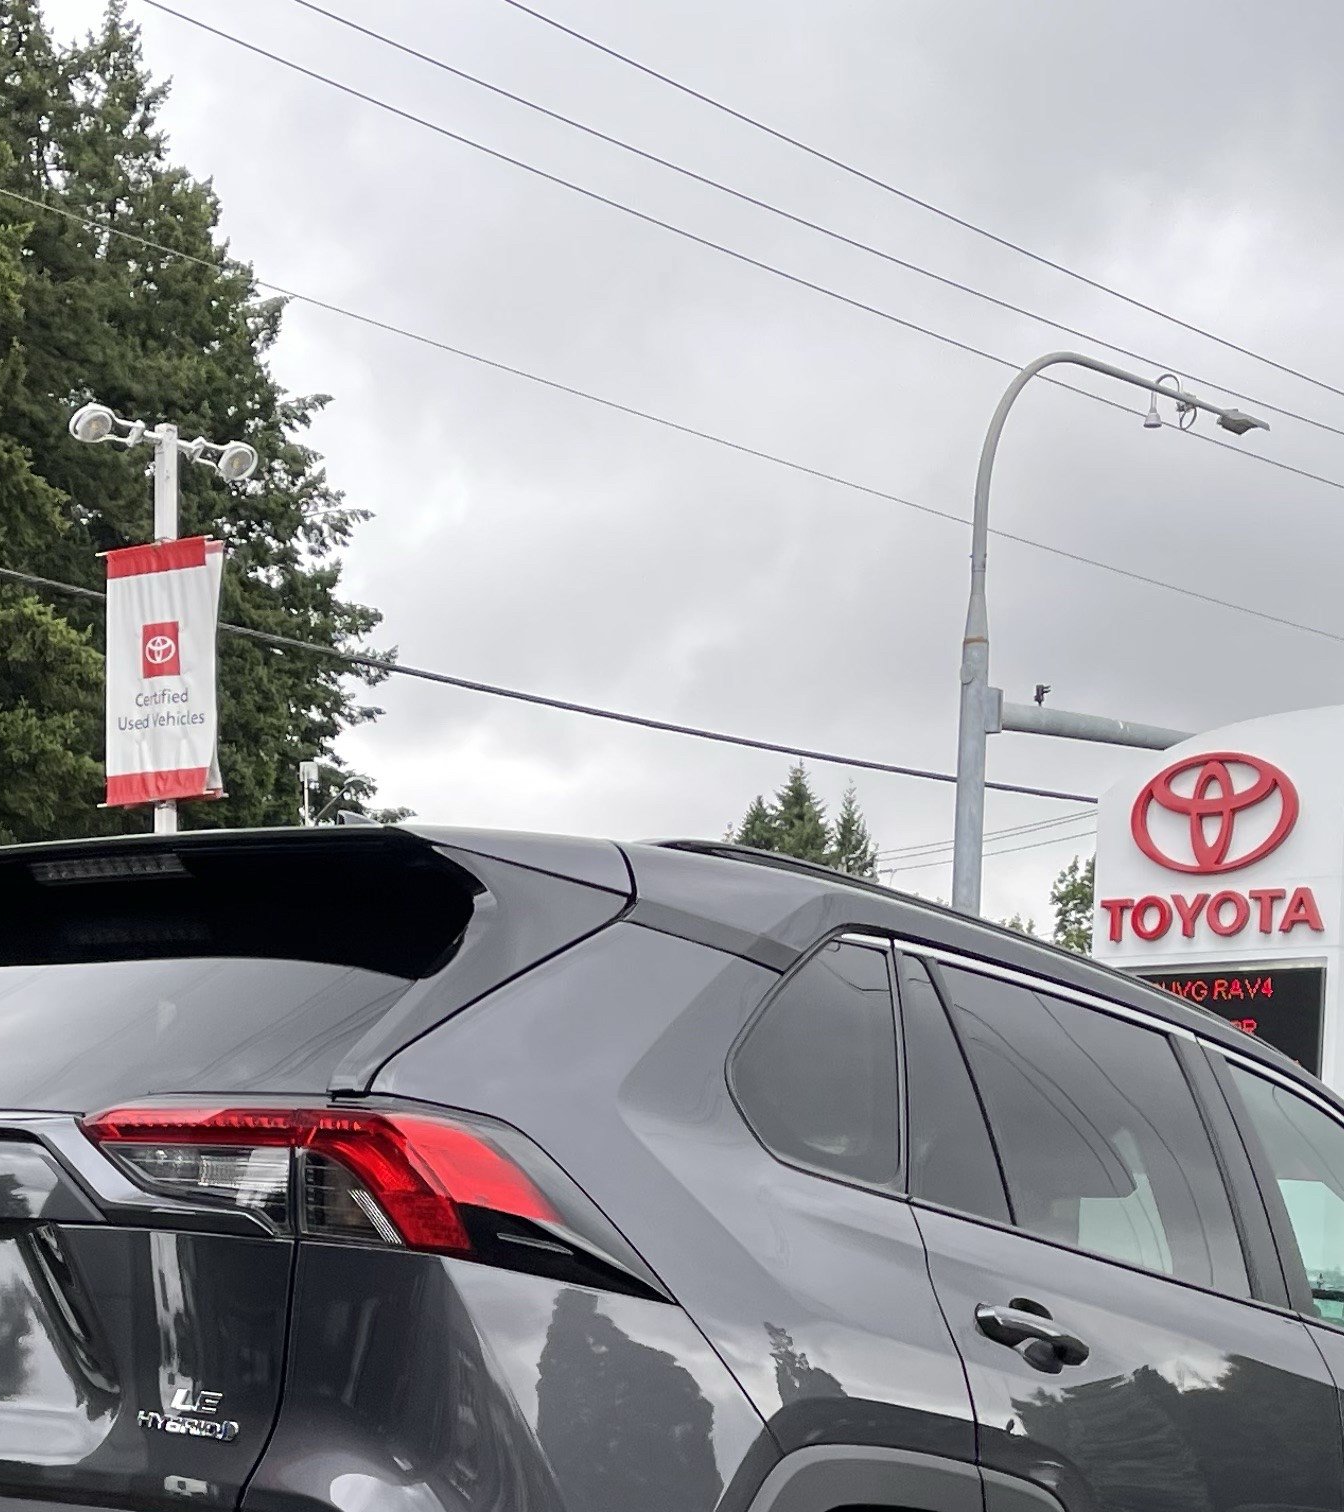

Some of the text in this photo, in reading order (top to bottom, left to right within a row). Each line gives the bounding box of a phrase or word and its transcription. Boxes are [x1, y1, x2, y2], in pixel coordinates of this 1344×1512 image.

[135, 688, 189, 708] Certified
[118, 710, 205, 731] Used Vehicles
[1100, 886, 1325, 943] TOYOTA
[1213, 976, 1274, 1001] RAV4
[170, 1388, 224, 1415] LE
